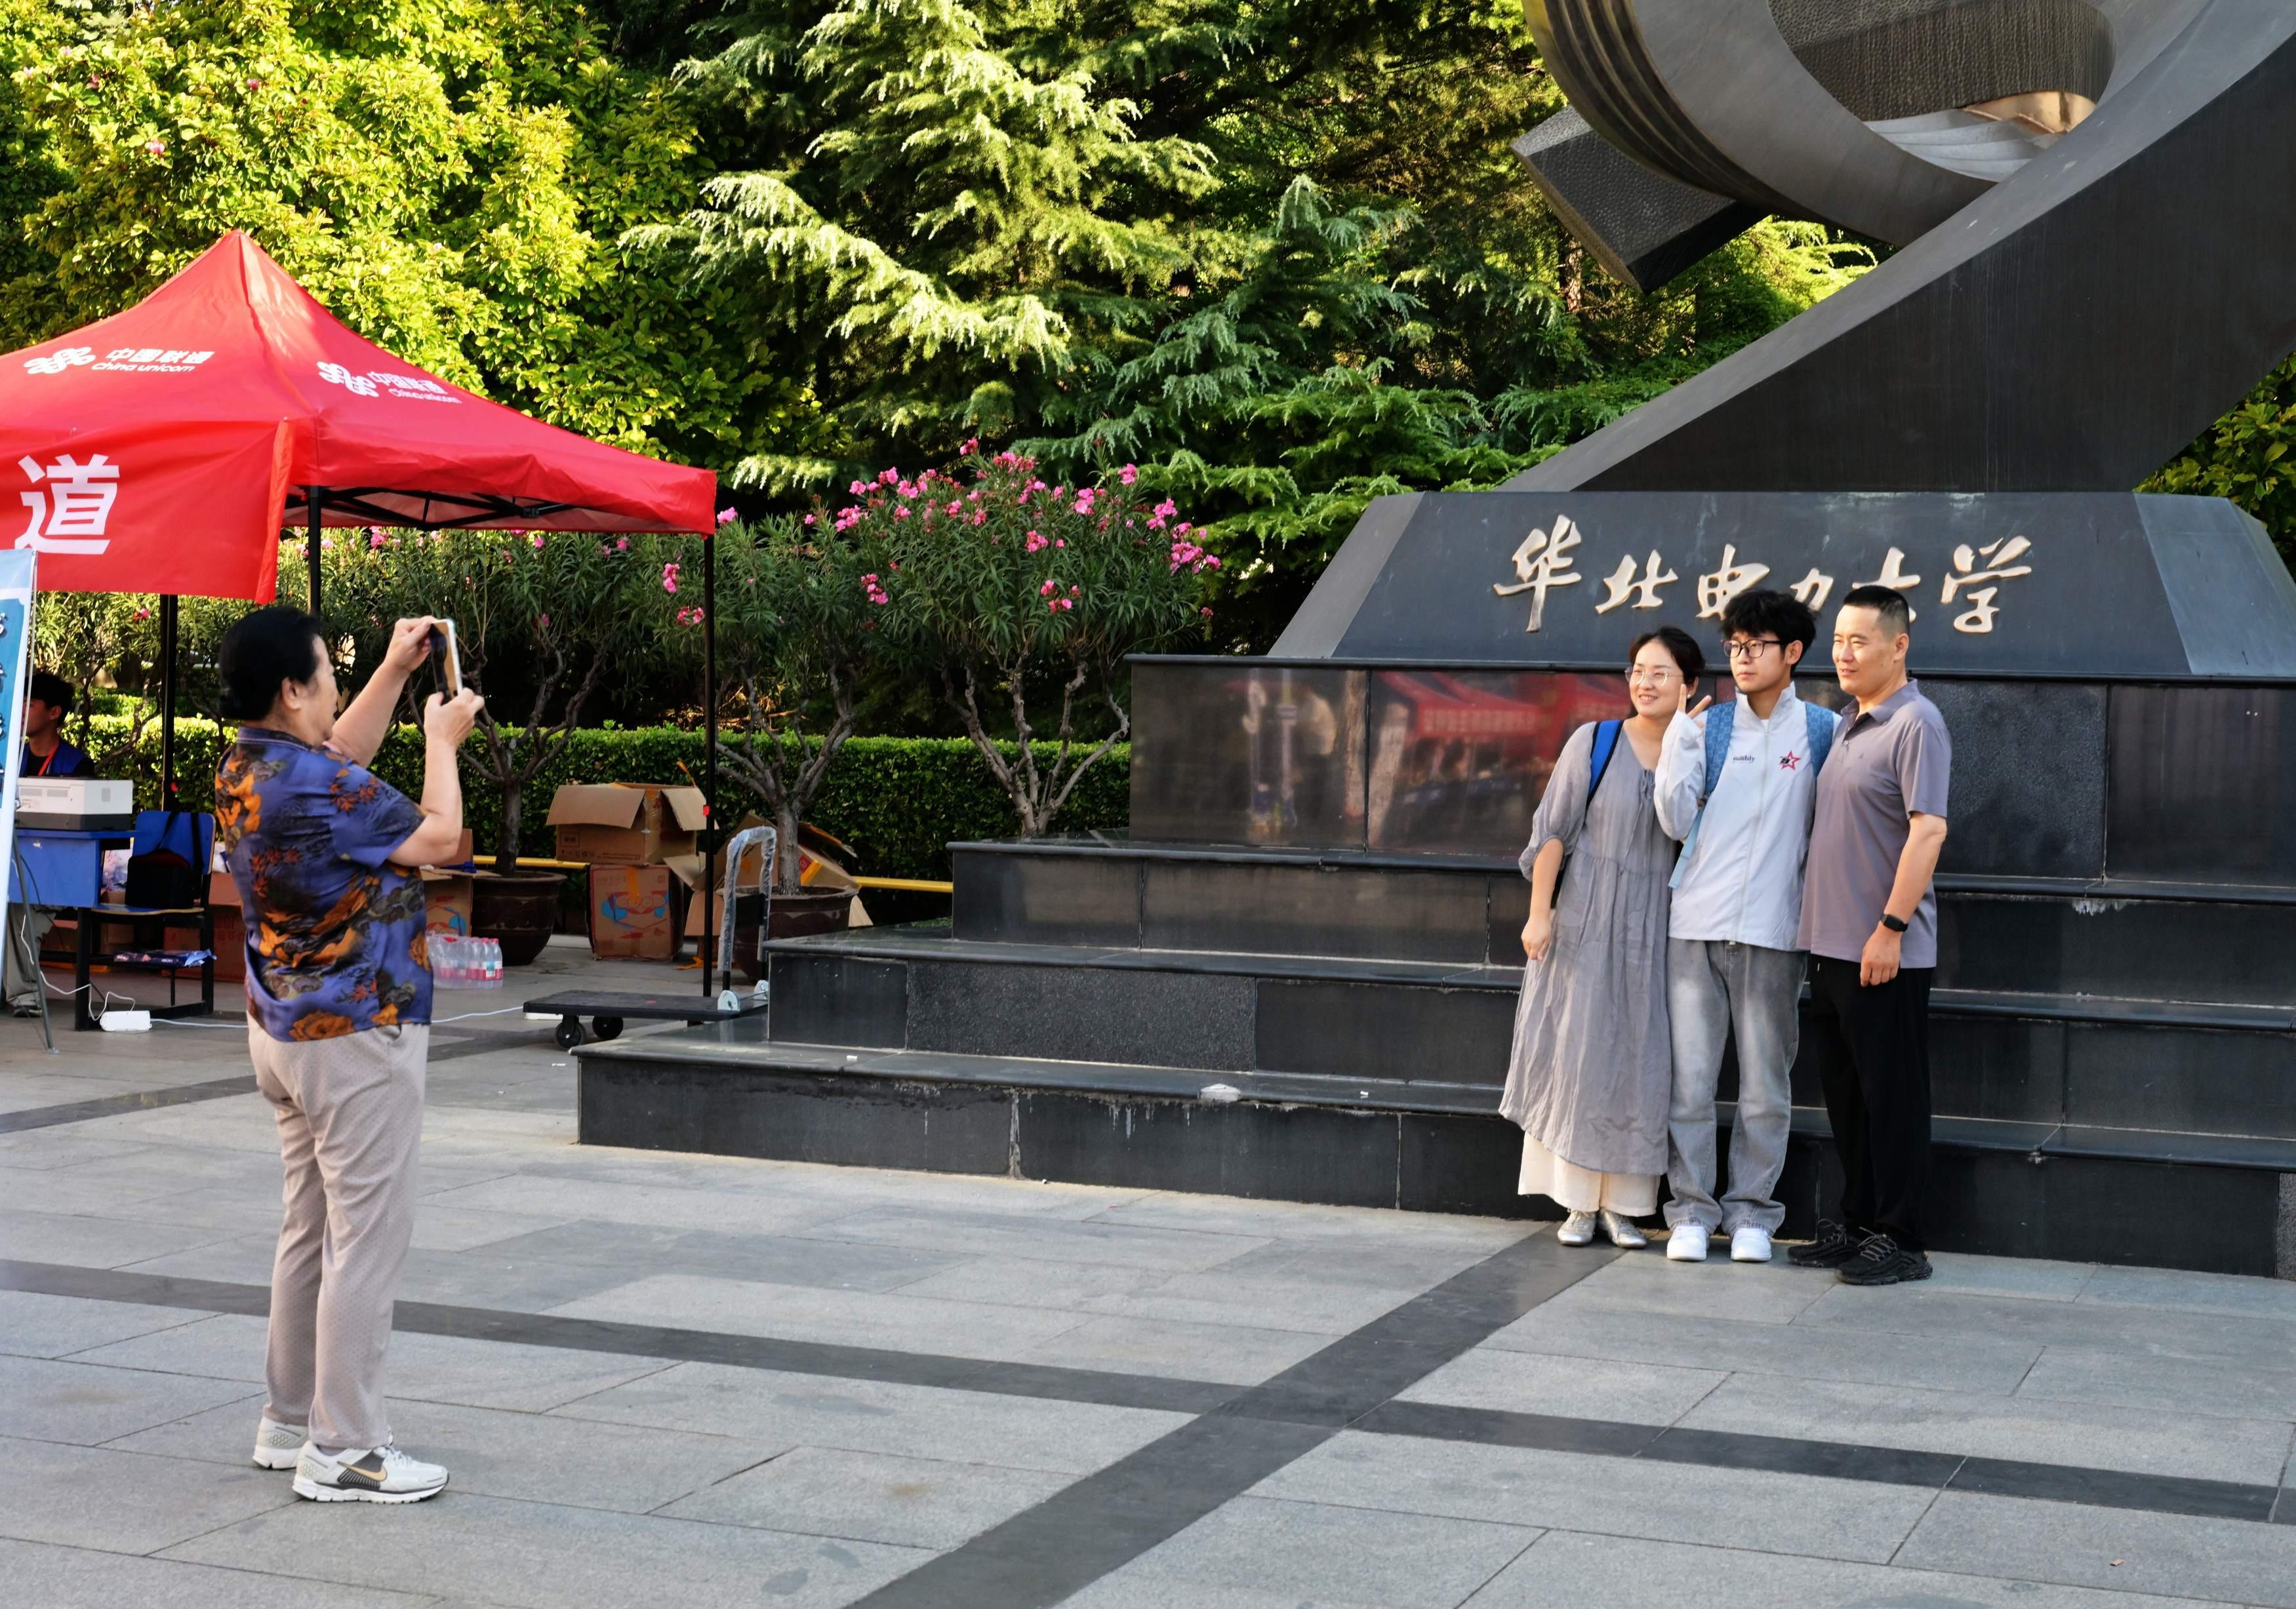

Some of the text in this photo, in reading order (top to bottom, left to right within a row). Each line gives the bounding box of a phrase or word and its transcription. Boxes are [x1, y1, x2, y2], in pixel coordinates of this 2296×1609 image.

[106, 348, 215, 364] 中国联通
[137, 364, 195, 372] unicom
[14, 453, 121, 555] 道
